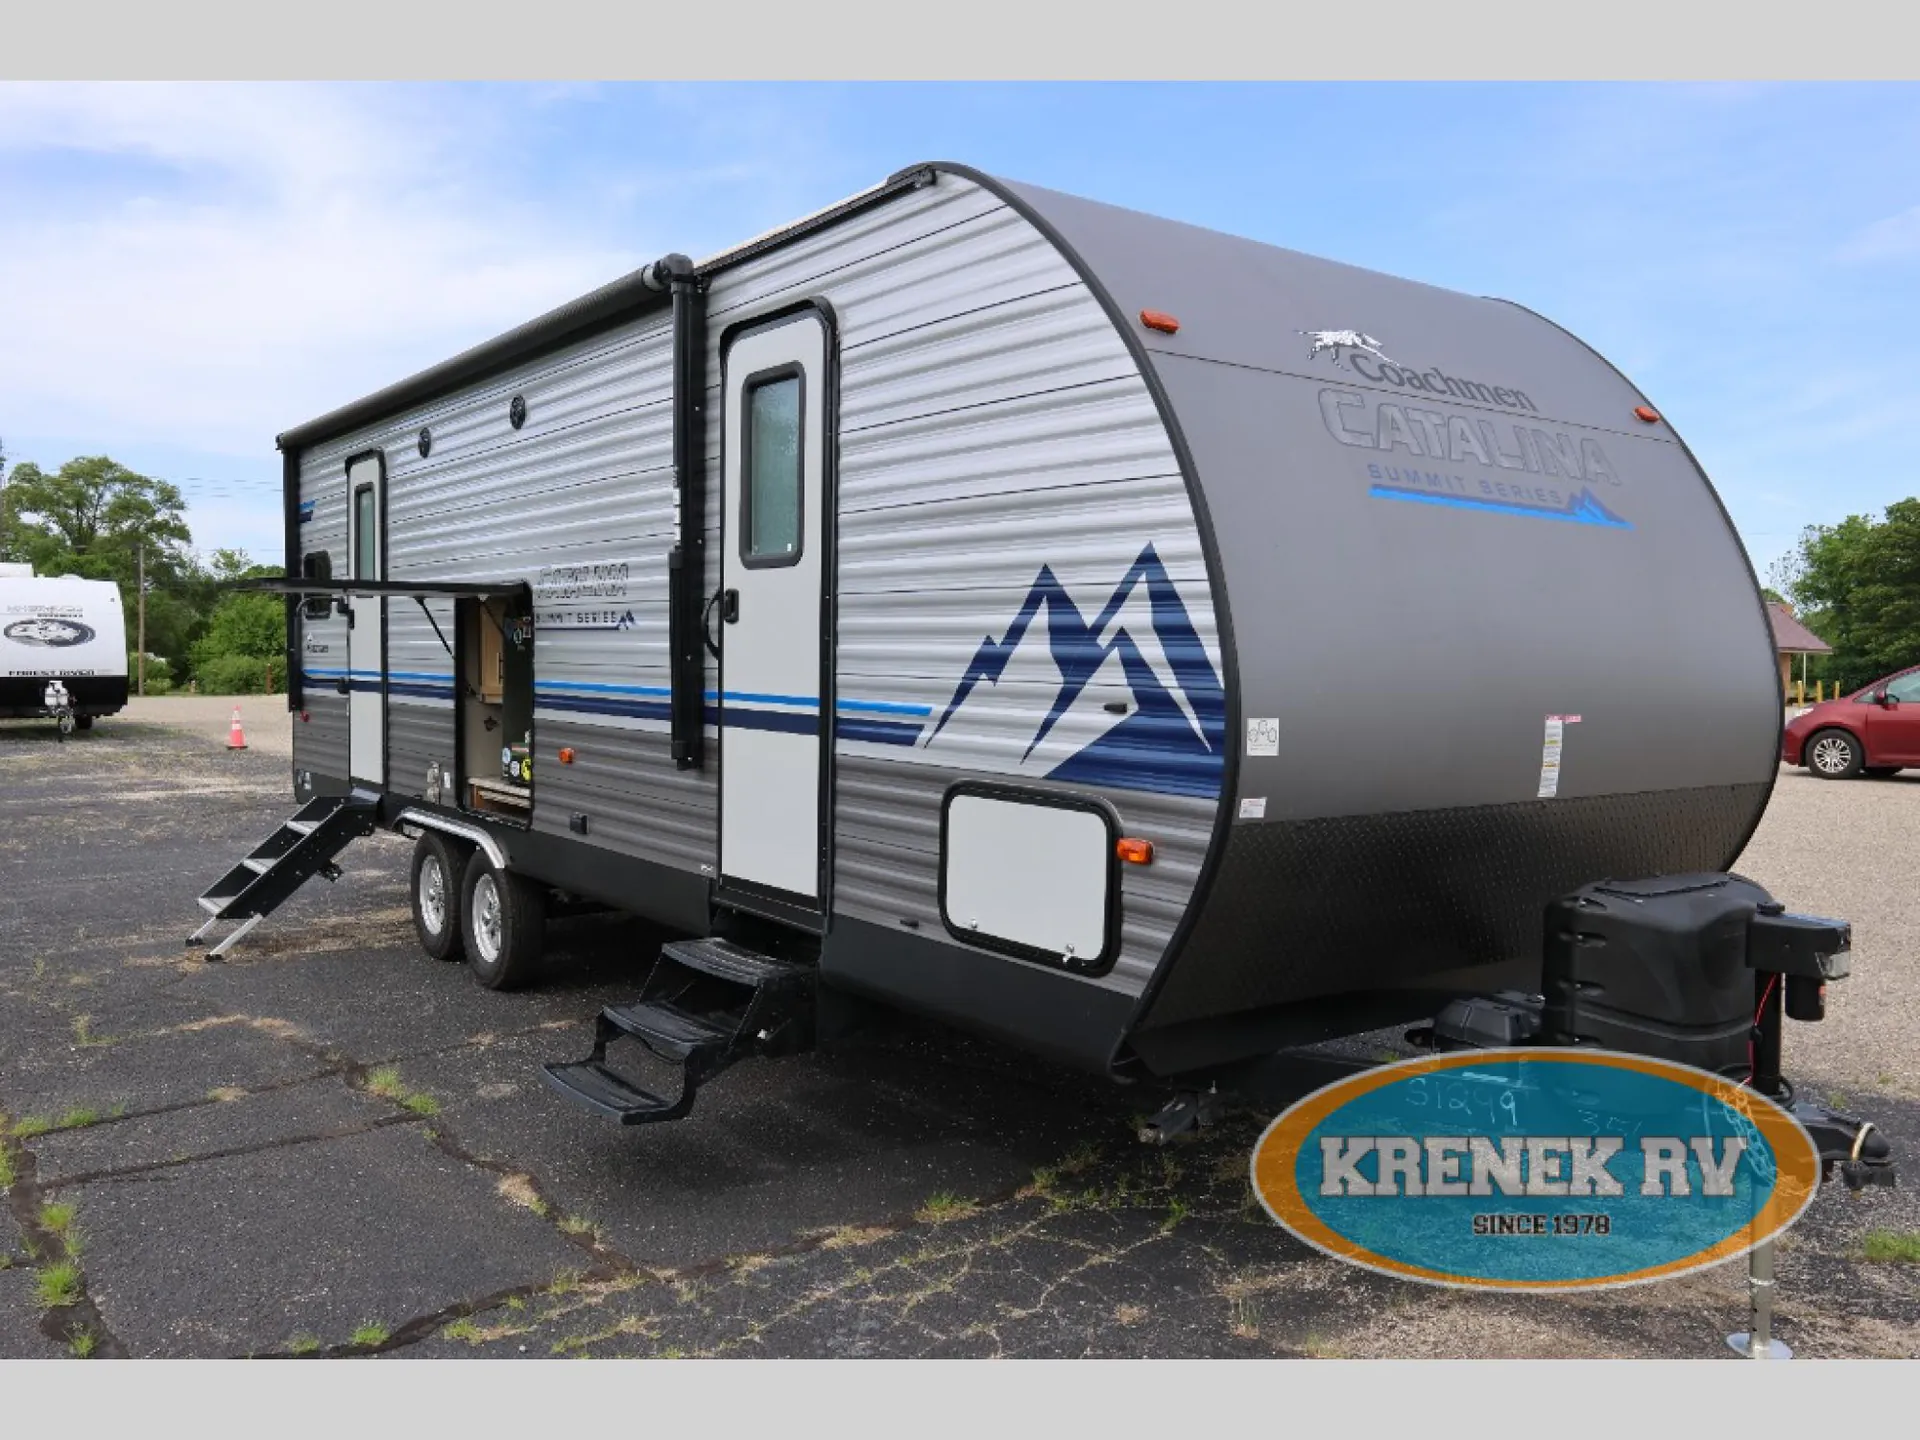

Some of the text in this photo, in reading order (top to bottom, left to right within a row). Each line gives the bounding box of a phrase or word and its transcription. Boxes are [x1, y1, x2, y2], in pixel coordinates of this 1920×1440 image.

[1350, 353, 1540, 412] Coachmen
[1318, 388, 1622, 486] CATALINA
[1366, 463, 1564, 505] SUMMIT SERIES
